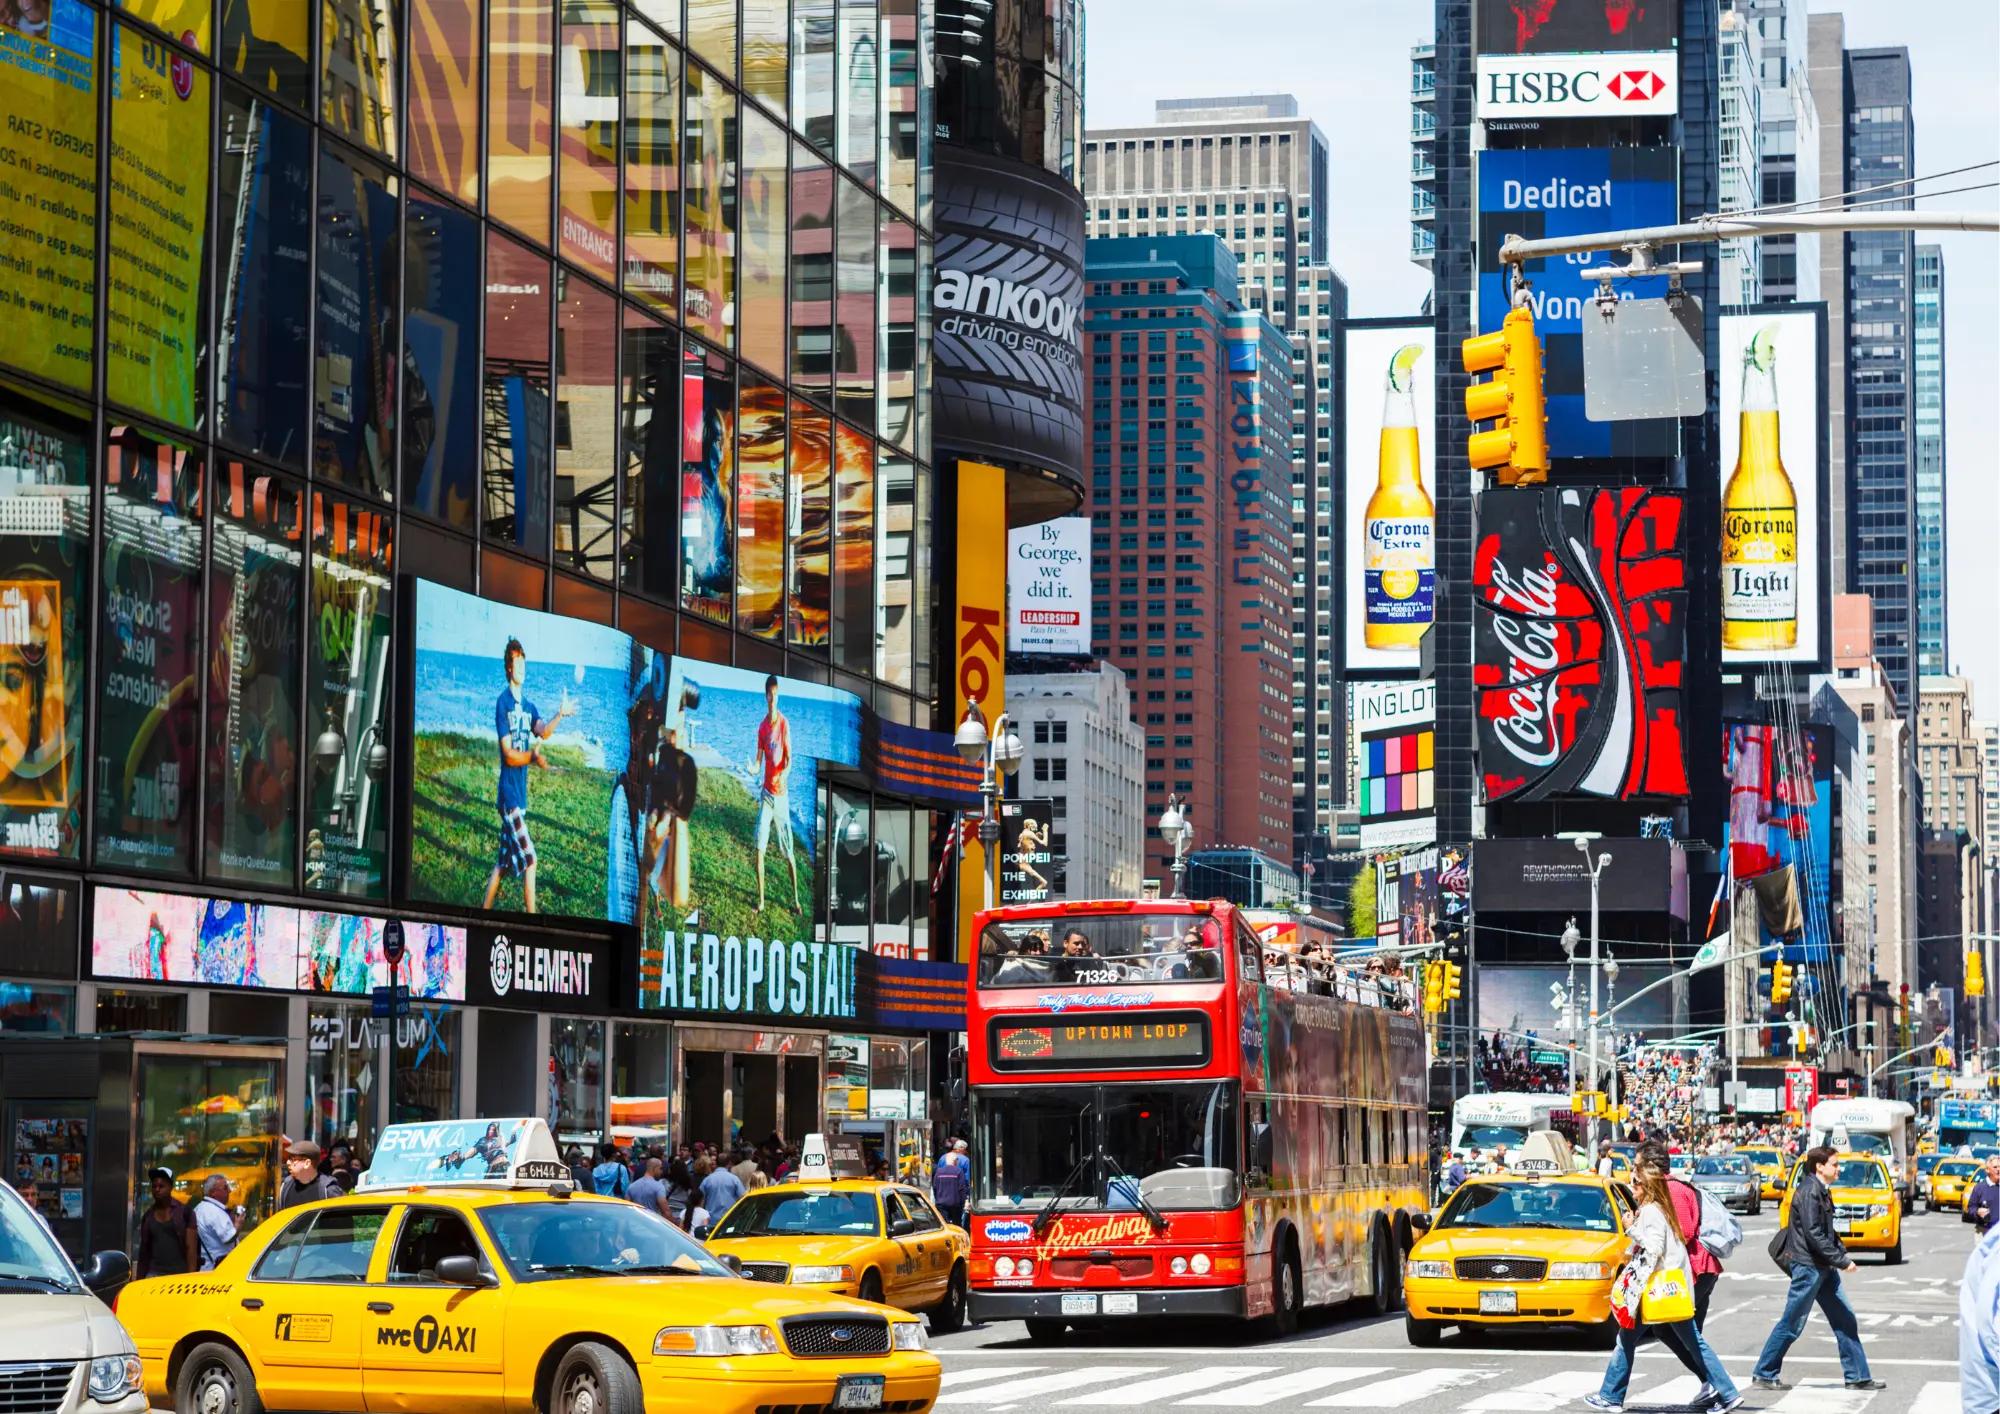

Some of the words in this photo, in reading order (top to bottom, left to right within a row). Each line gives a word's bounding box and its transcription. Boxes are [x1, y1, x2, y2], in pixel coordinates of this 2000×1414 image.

[1488, 71, 1599, 103] HSBC
[1504, 178, 1611, 209] Dedicat
[563, 216, 614, 264] ENTRANCE
[629, 255, 644, 283] ON
[941, 315, 1019, 350] driving
[1022, 334, 1076, 369] emotion
[1231, 380, 1254, 584] NOVOTEL
[1041, 525, 1061, 545] By
[1370, 520, 1430, 542] Corona
[1727, 516, 1793, 541] Corona
[1018, 543, 1082, 565] George,
[1384, 539, 1422, 550] Extra
[1040, 566, 1061, 578] we
[1732, 567, 1789, 598] Light
[1027, 580, 1053, 598] did
[1057, 582, 1072, 598] it.
[1022, 611, 1076, 624] LEADERSHIP
[1361, 685, 1437, 720] INGLOT
[219, 851, 281, 872] MonkeyQuest.com
[1003, 853, 1051, 864] POMPEII
[1003, 872, 1026, 882] THE
[1003, 889, 1048, 900] EXHIBIT
[514, 945, 593, 995] ELEMENT
[1075, 970, 1118, 984] 71326
[1066, 1025, 1133, 1041] UPTOWN
[1143, 1023, 1188, 1039] LOOP
[380, 1125, 448, 1152] BRINK
[529, 1163, 556, 1178] 6H44
[1525, 1160, 1547, 1170] 3V48
[991, 1220, 1010, 1230] Hop
[1011, 1219, 1025, 1229] On
[991, 1233, 1010, 1242] Hop
[1037, 1216, 1156, 1262] Broadway
[377, 1327, 412, 1348] NYC
[418, 1321, 477, 1353] TAXI
